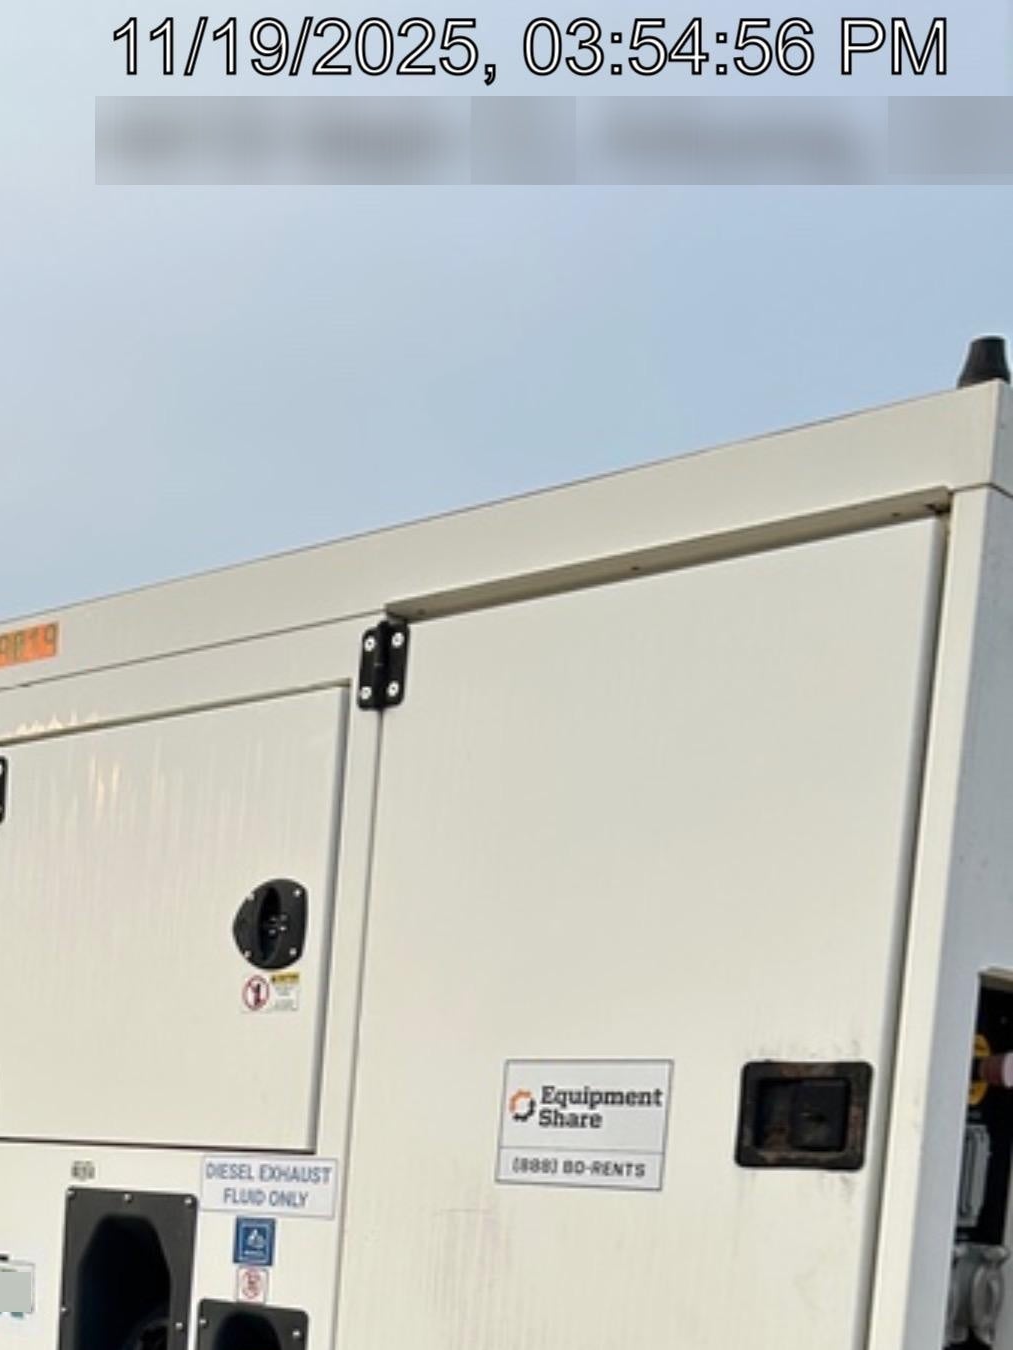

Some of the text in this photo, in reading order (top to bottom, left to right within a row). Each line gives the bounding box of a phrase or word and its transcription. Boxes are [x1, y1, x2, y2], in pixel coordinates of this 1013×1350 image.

[540, 1085, 662, 1109] Equipment
[538, 1109, 604, 1129] Share
[205, 1162, 333, 1185] DIESEL EXHAUST
[512, 1156, 559, 1175] (888)
[223, 1187, 309, 1208] FLUID ONLY
